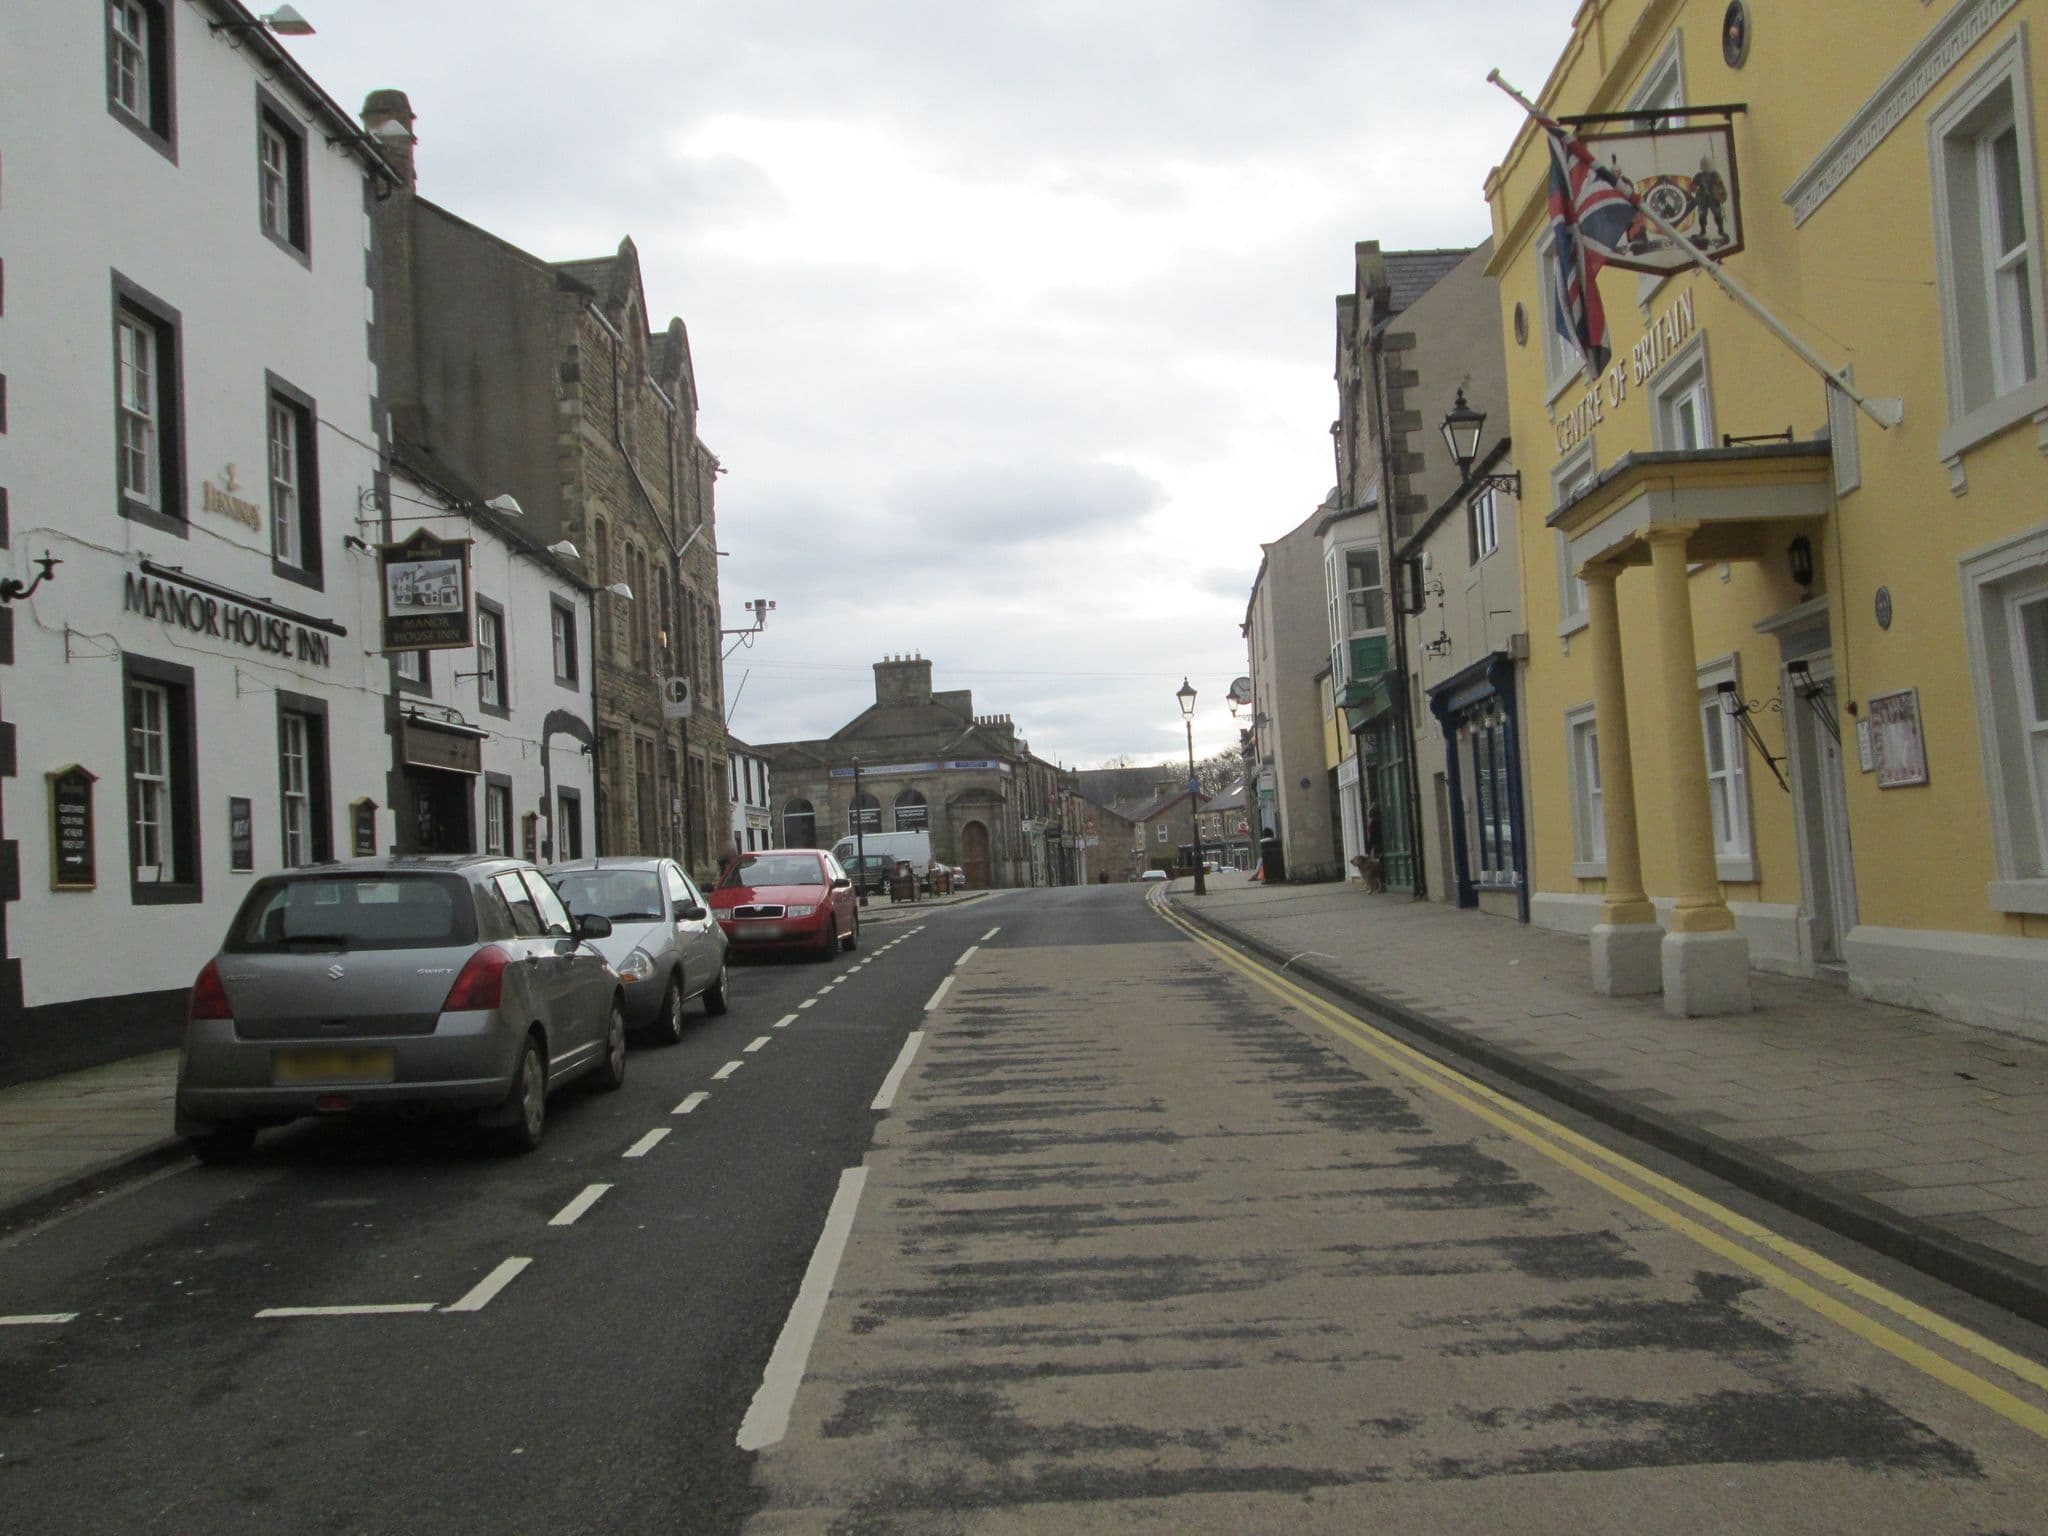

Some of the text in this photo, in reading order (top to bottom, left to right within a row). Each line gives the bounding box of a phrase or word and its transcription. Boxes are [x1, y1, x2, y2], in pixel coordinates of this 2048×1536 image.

[1555, 287, 1696, 456] CENTRE OF BRITAIN
[123, 571, 330, 668] MANOR HOUSE INN
[437, 629, 460, 641] INN
[416, 967, 454, 976] SWIFT
